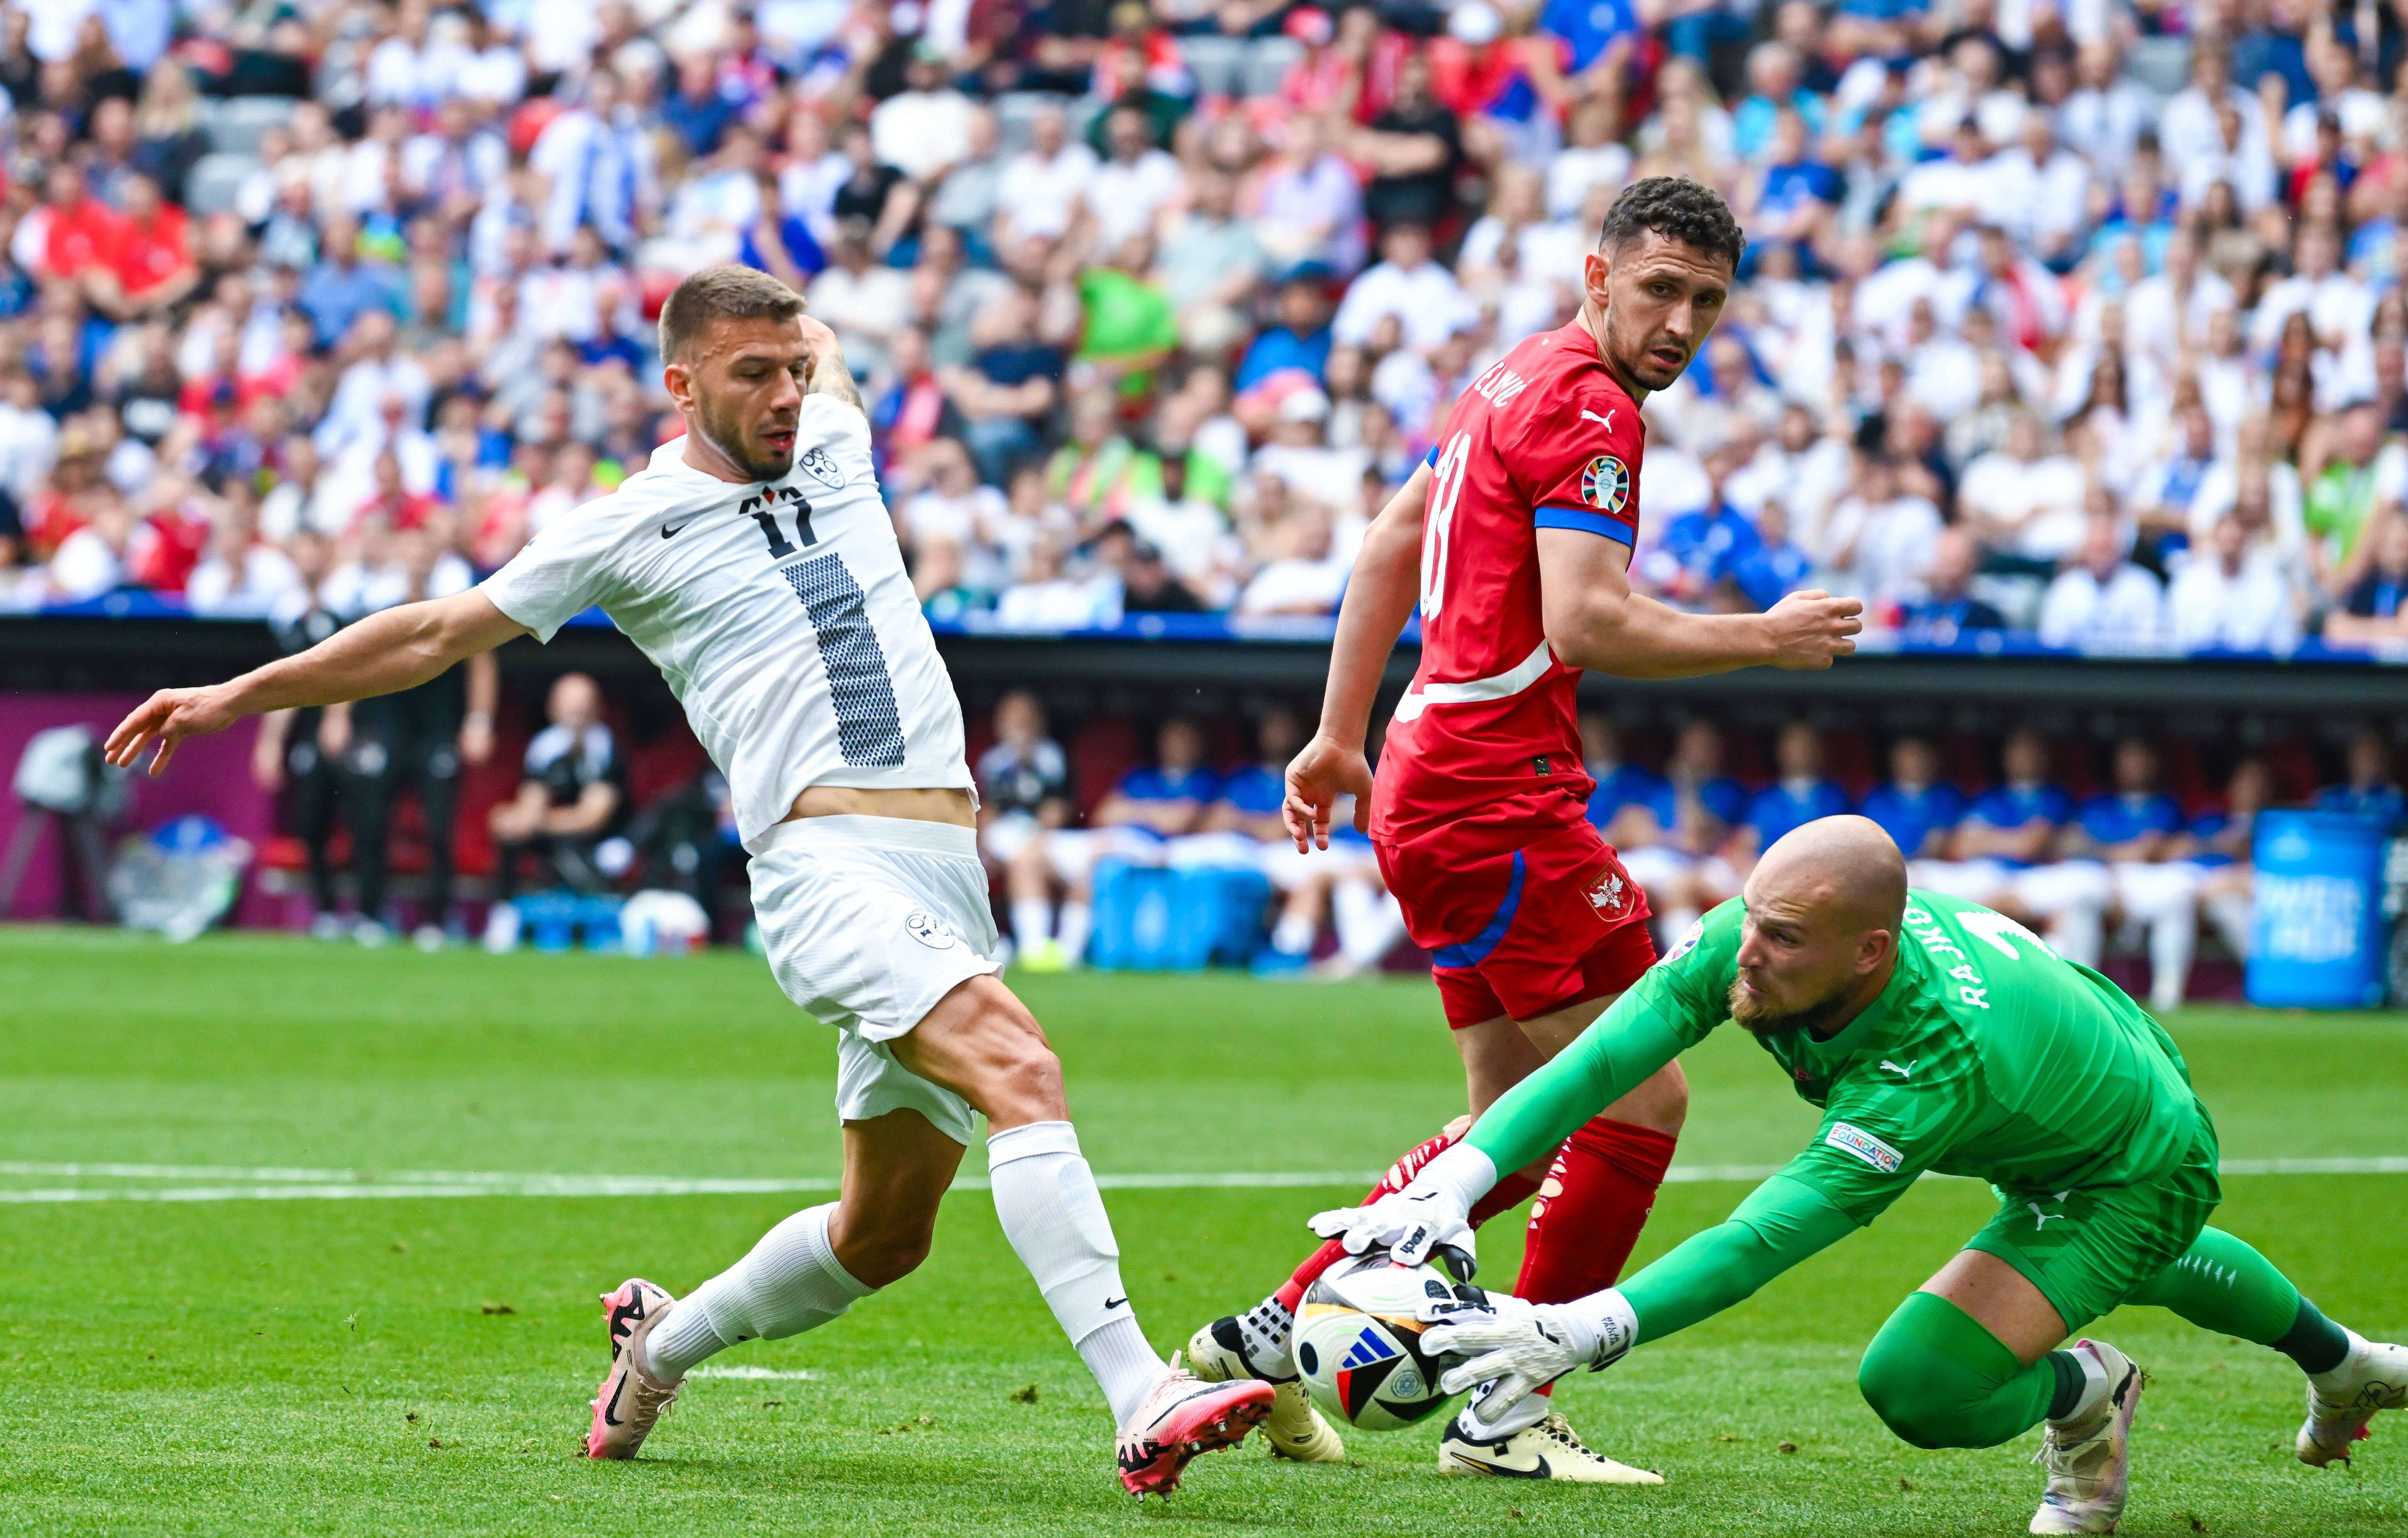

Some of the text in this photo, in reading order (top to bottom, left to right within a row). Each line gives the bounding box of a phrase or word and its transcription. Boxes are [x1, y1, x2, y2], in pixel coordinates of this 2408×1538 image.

[745, 493, 818, 559] 17
[1420, 429, 1471, 623] 13
[1903, 895, 1990, 1009] RAJKO
[1831, 1129, 1898, 1169] FOUNDATION
